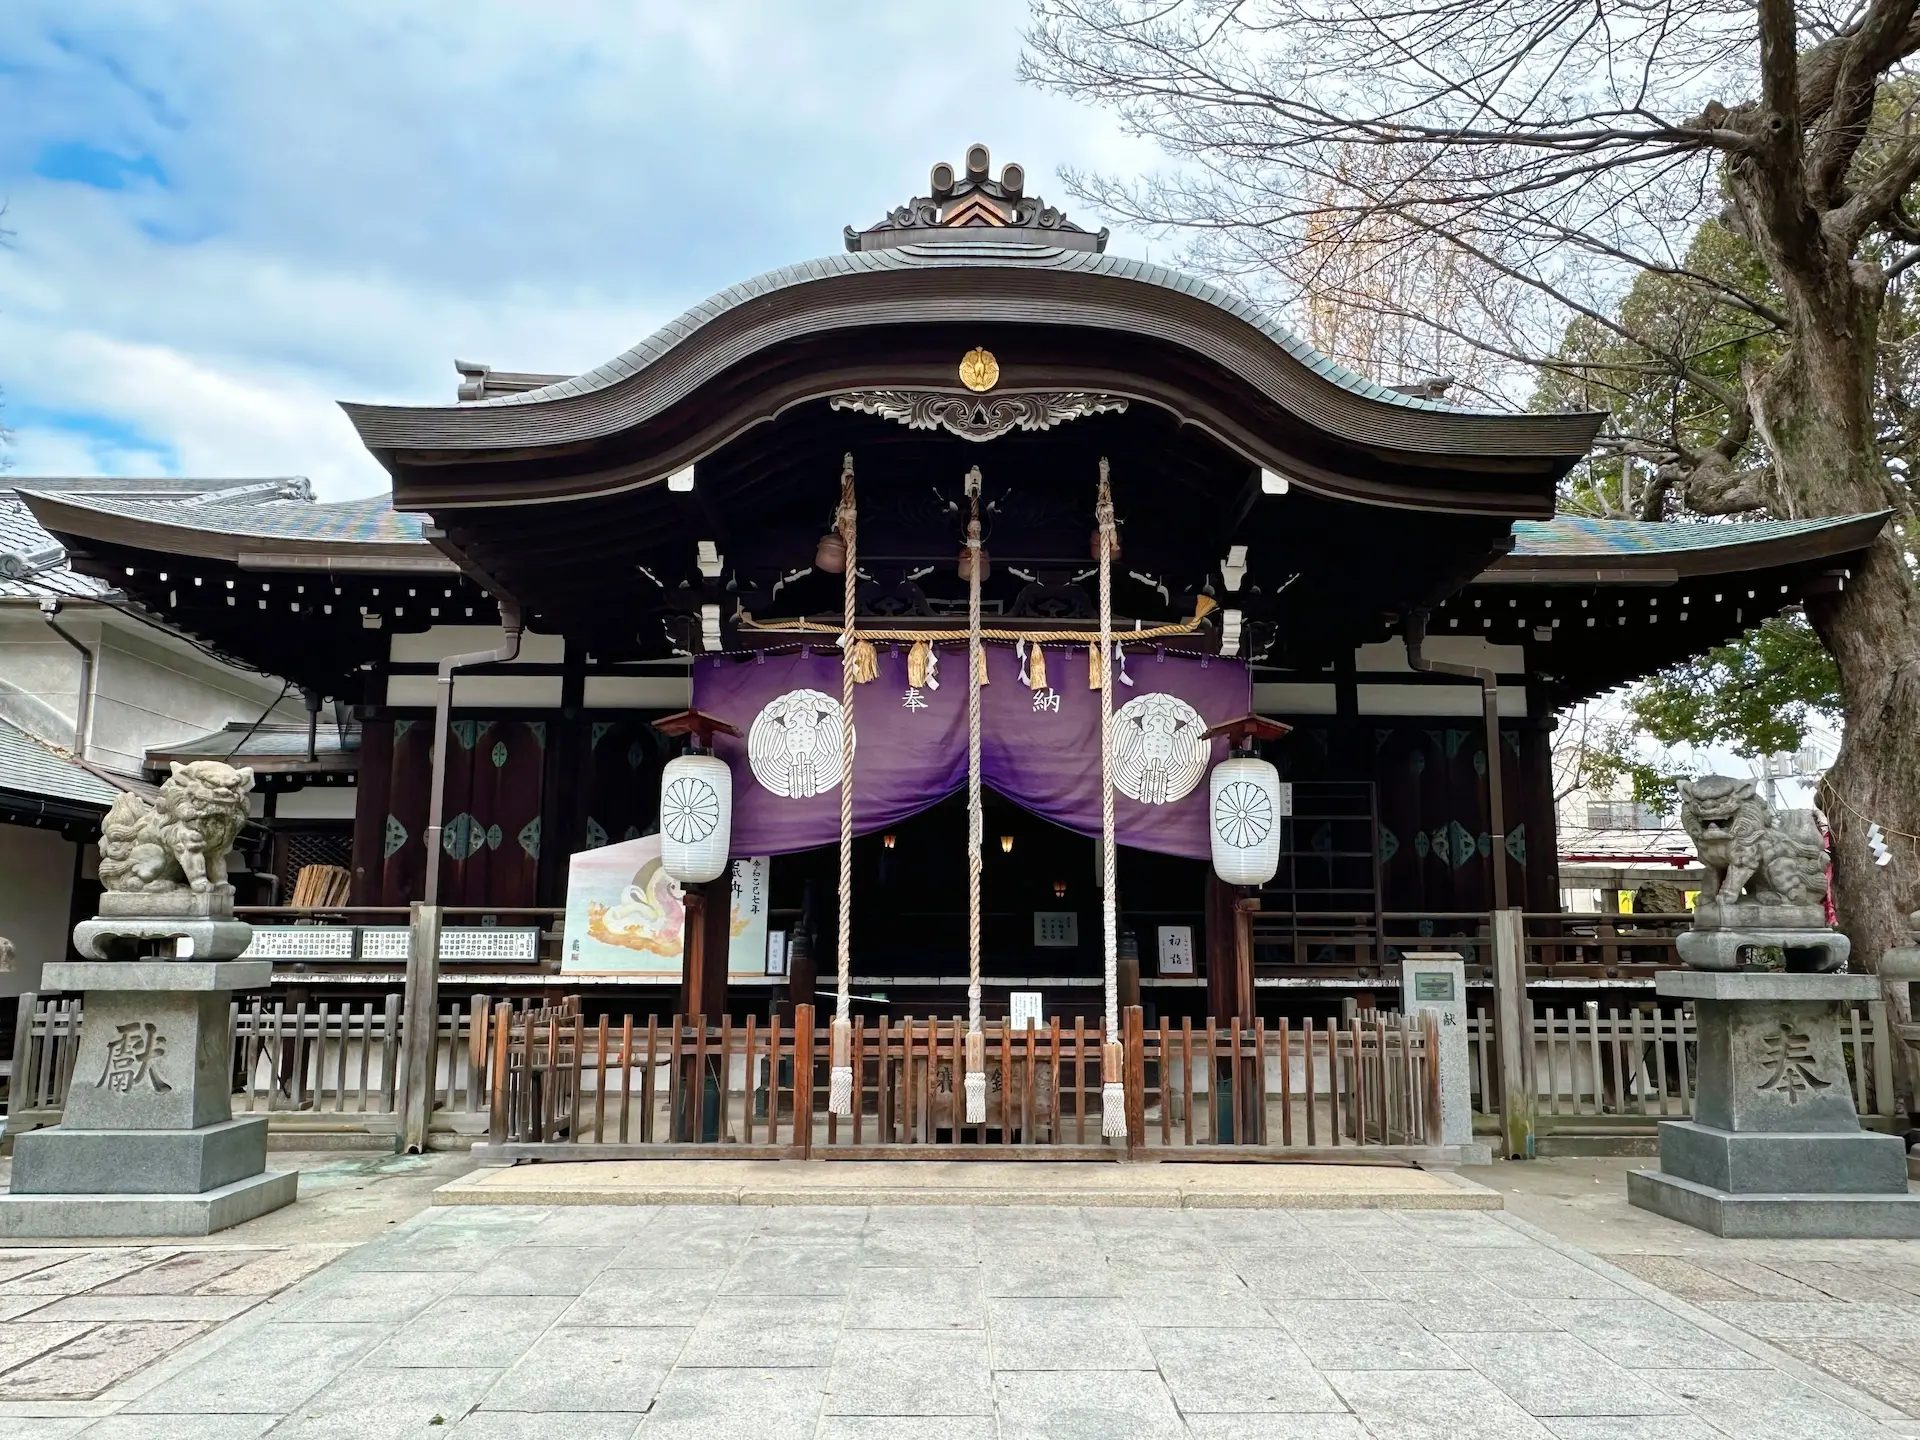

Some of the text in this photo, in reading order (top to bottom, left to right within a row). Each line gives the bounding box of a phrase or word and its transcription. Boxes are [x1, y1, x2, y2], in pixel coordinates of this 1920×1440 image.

[902, 687, 1061, 713] 奉 納
[1757, 1023, 1832, 1105] 奉
